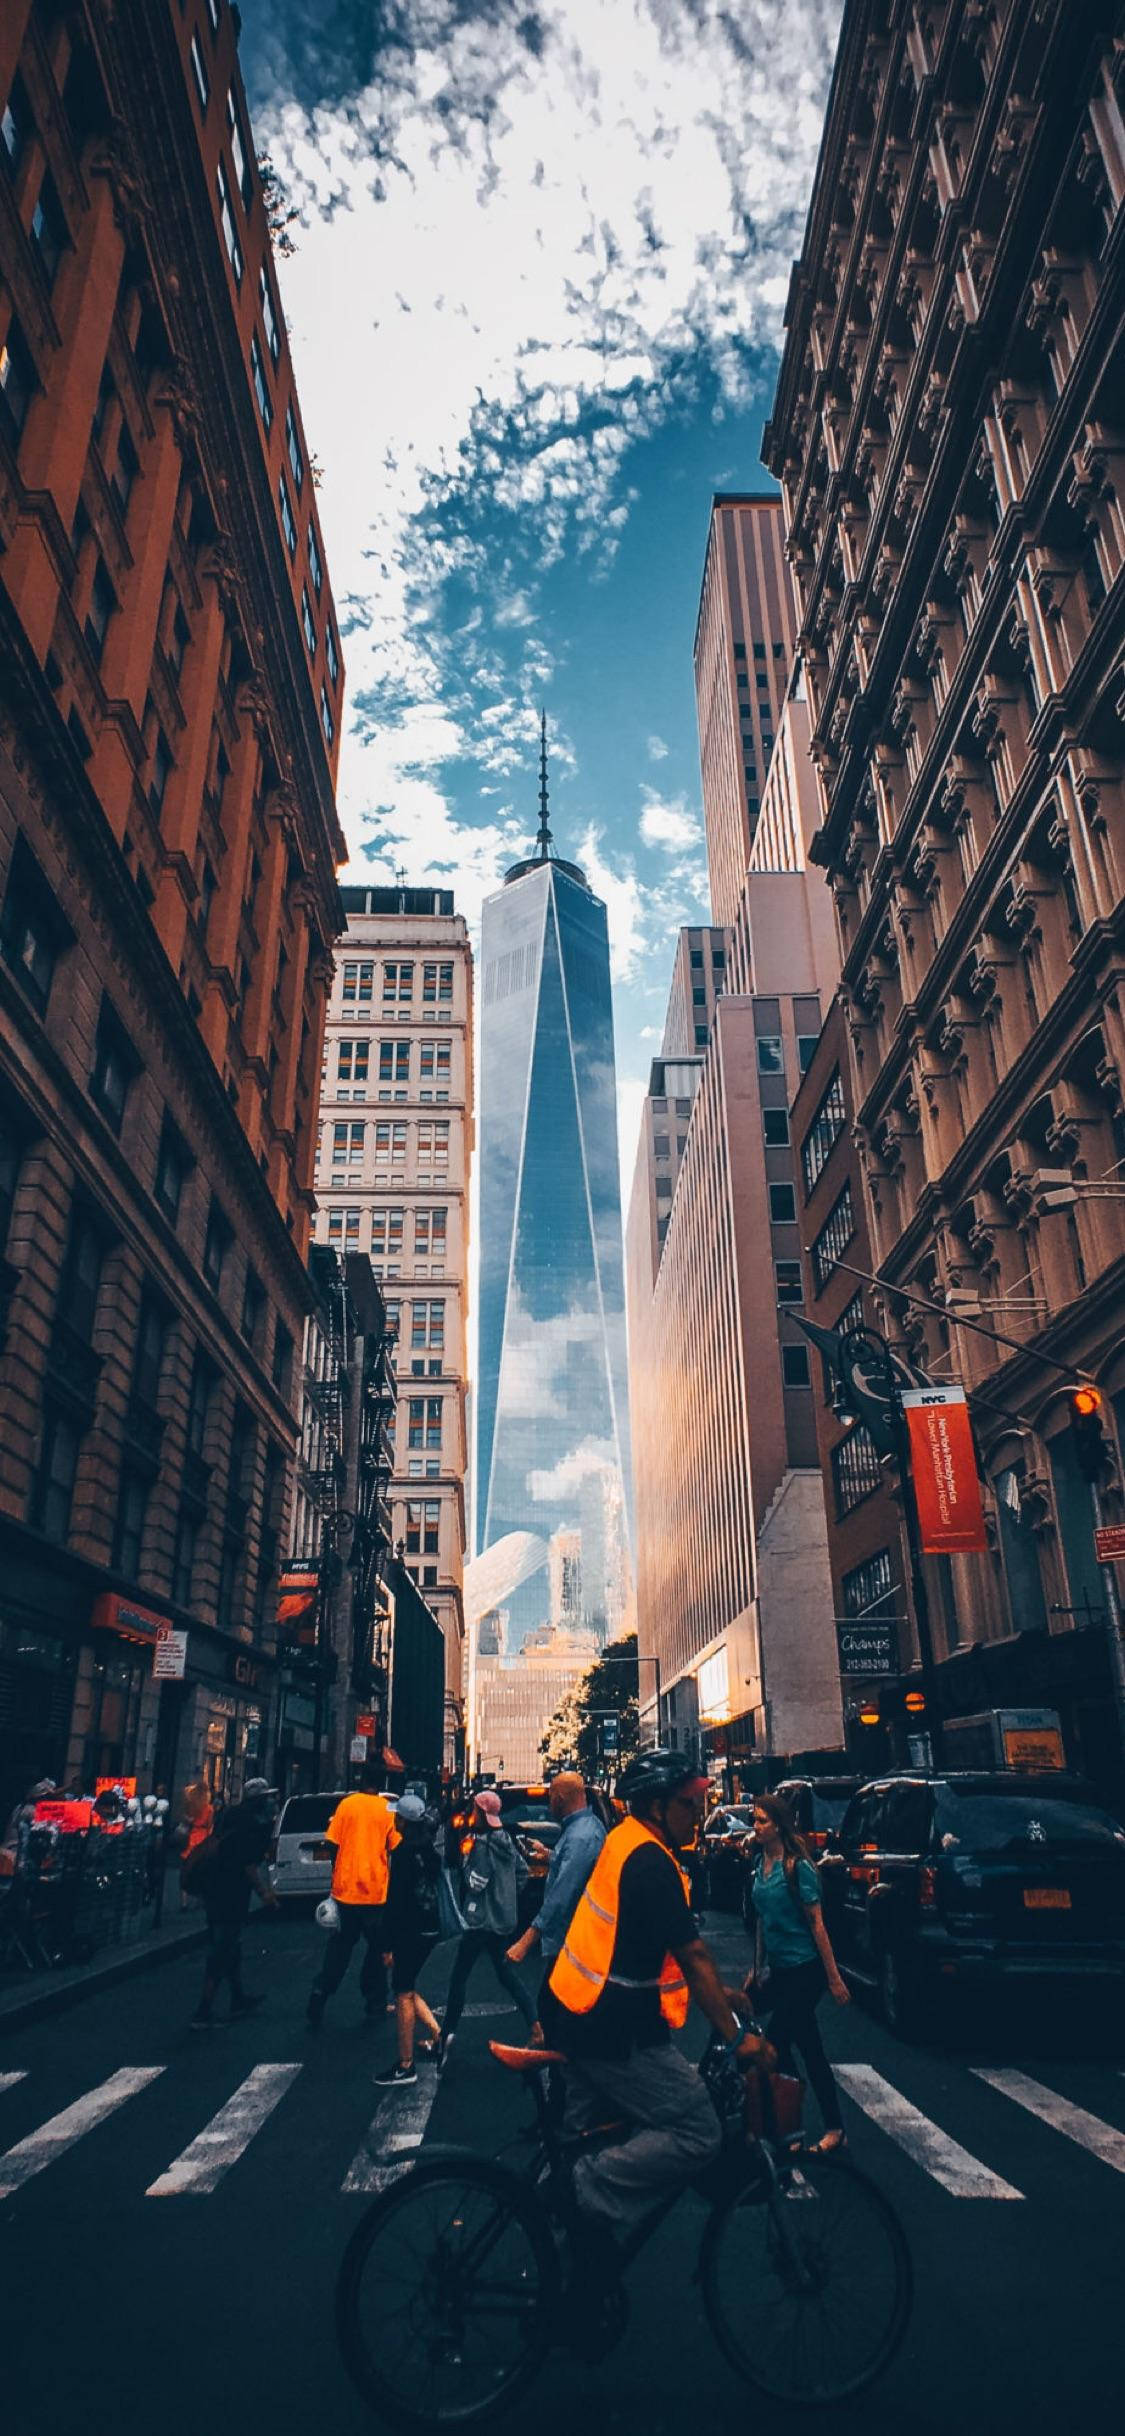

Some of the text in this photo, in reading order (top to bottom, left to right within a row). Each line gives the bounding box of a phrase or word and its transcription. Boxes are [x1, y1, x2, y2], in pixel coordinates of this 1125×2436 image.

[921, 1394, 946, 1405] NYC
[926, 1418, 951, 1525] Lower Manhattan Hospital
[841, 1635, 890, 1655] Champs
